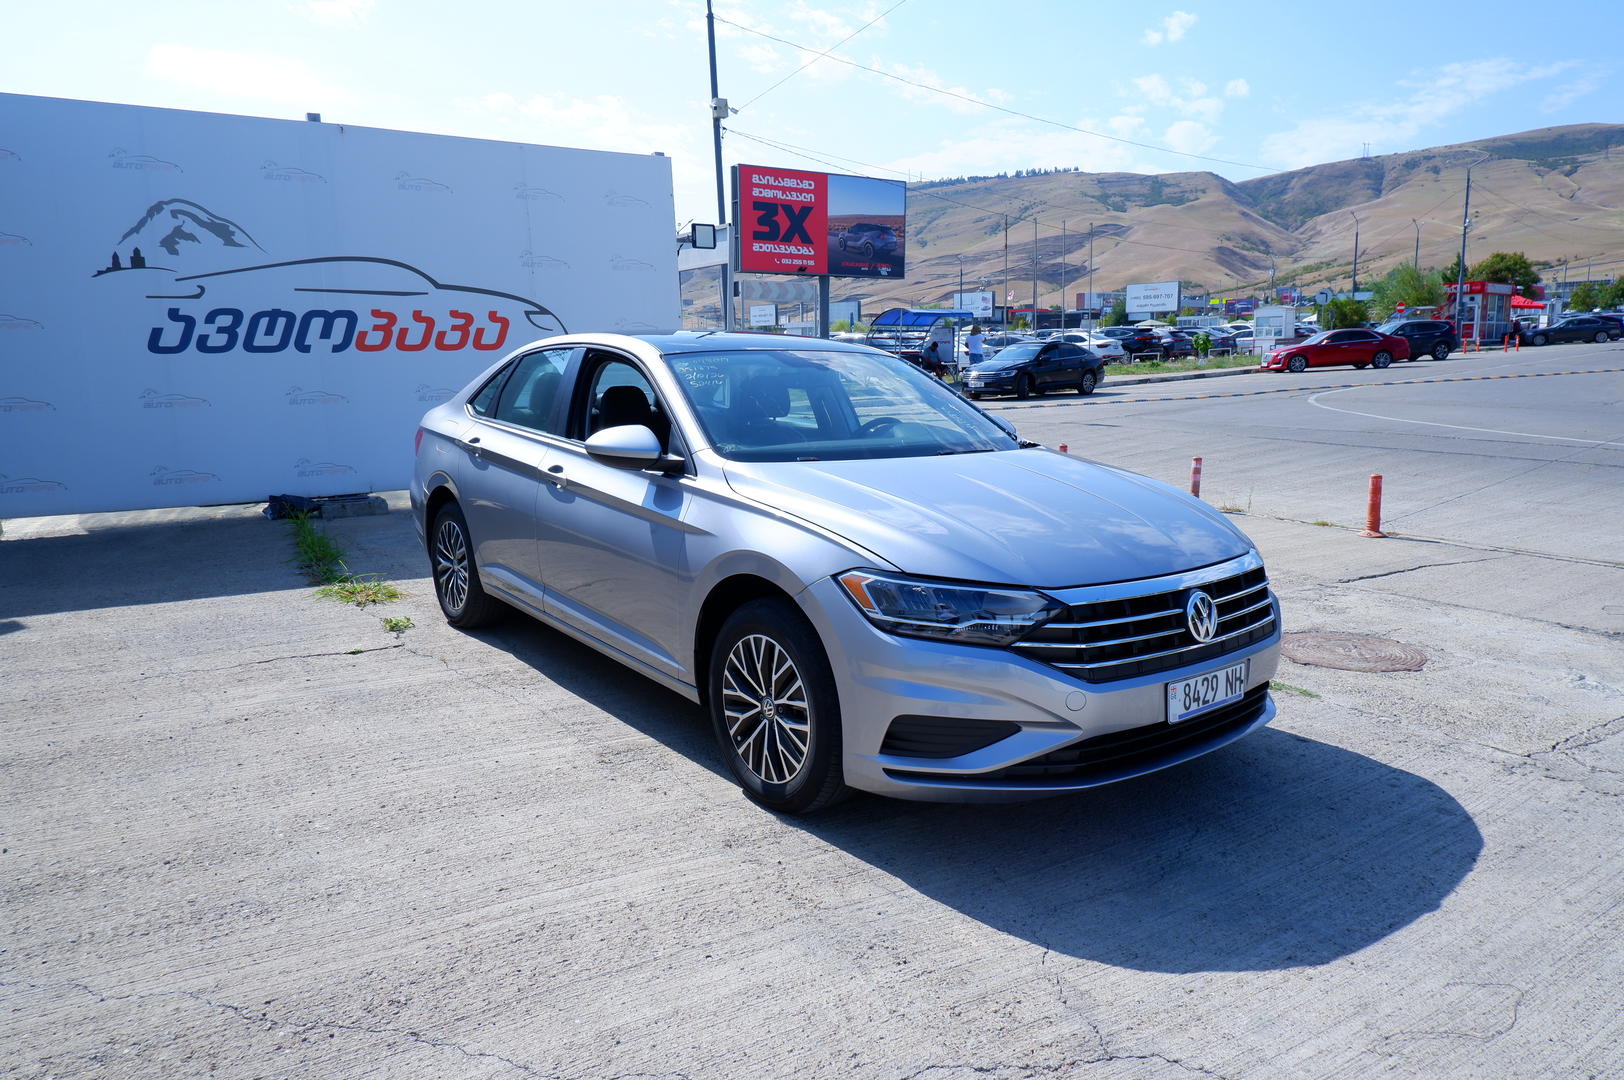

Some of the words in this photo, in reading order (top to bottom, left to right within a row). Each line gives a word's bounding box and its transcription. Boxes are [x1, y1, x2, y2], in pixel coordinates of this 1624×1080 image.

[752, 201, 814, 245] 3X
[147, 307, 510, 354] ავტოპაპა
[1187, 592, 1217, 642] VW
[1183, 675, 1218, 711] 8429
[1225, 667, 1244, 697] NH
